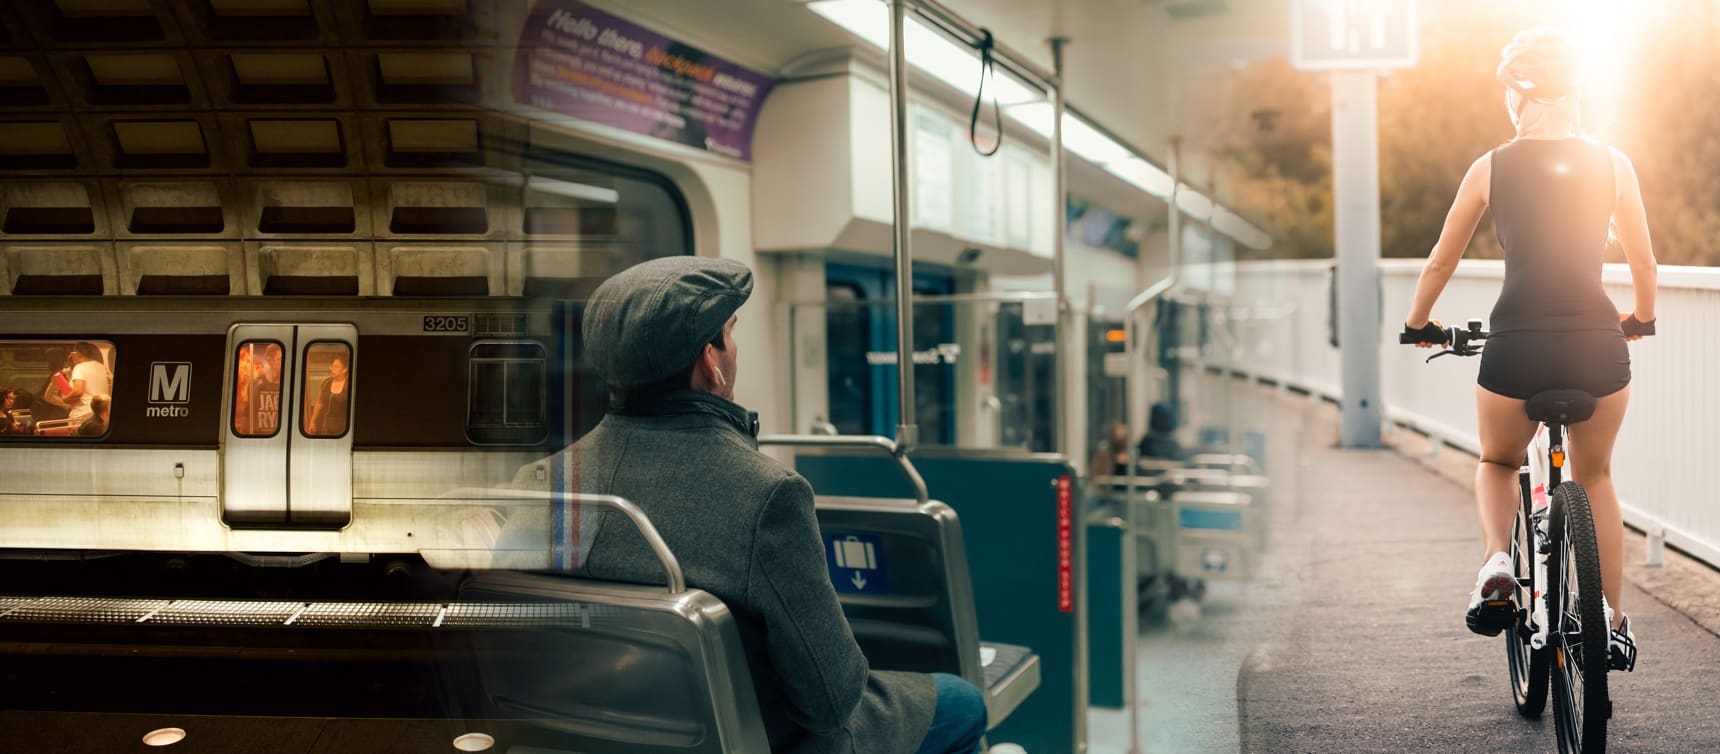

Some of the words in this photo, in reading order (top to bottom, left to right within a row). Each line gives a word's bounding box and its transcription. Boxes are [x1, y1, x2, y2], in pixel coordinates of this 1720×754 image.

[546, 8, 598, 40] Hello
[425, 317, 467, 331] 3205
[151, 364, 189, 400] M
[146, 405, 189, 417] metro
